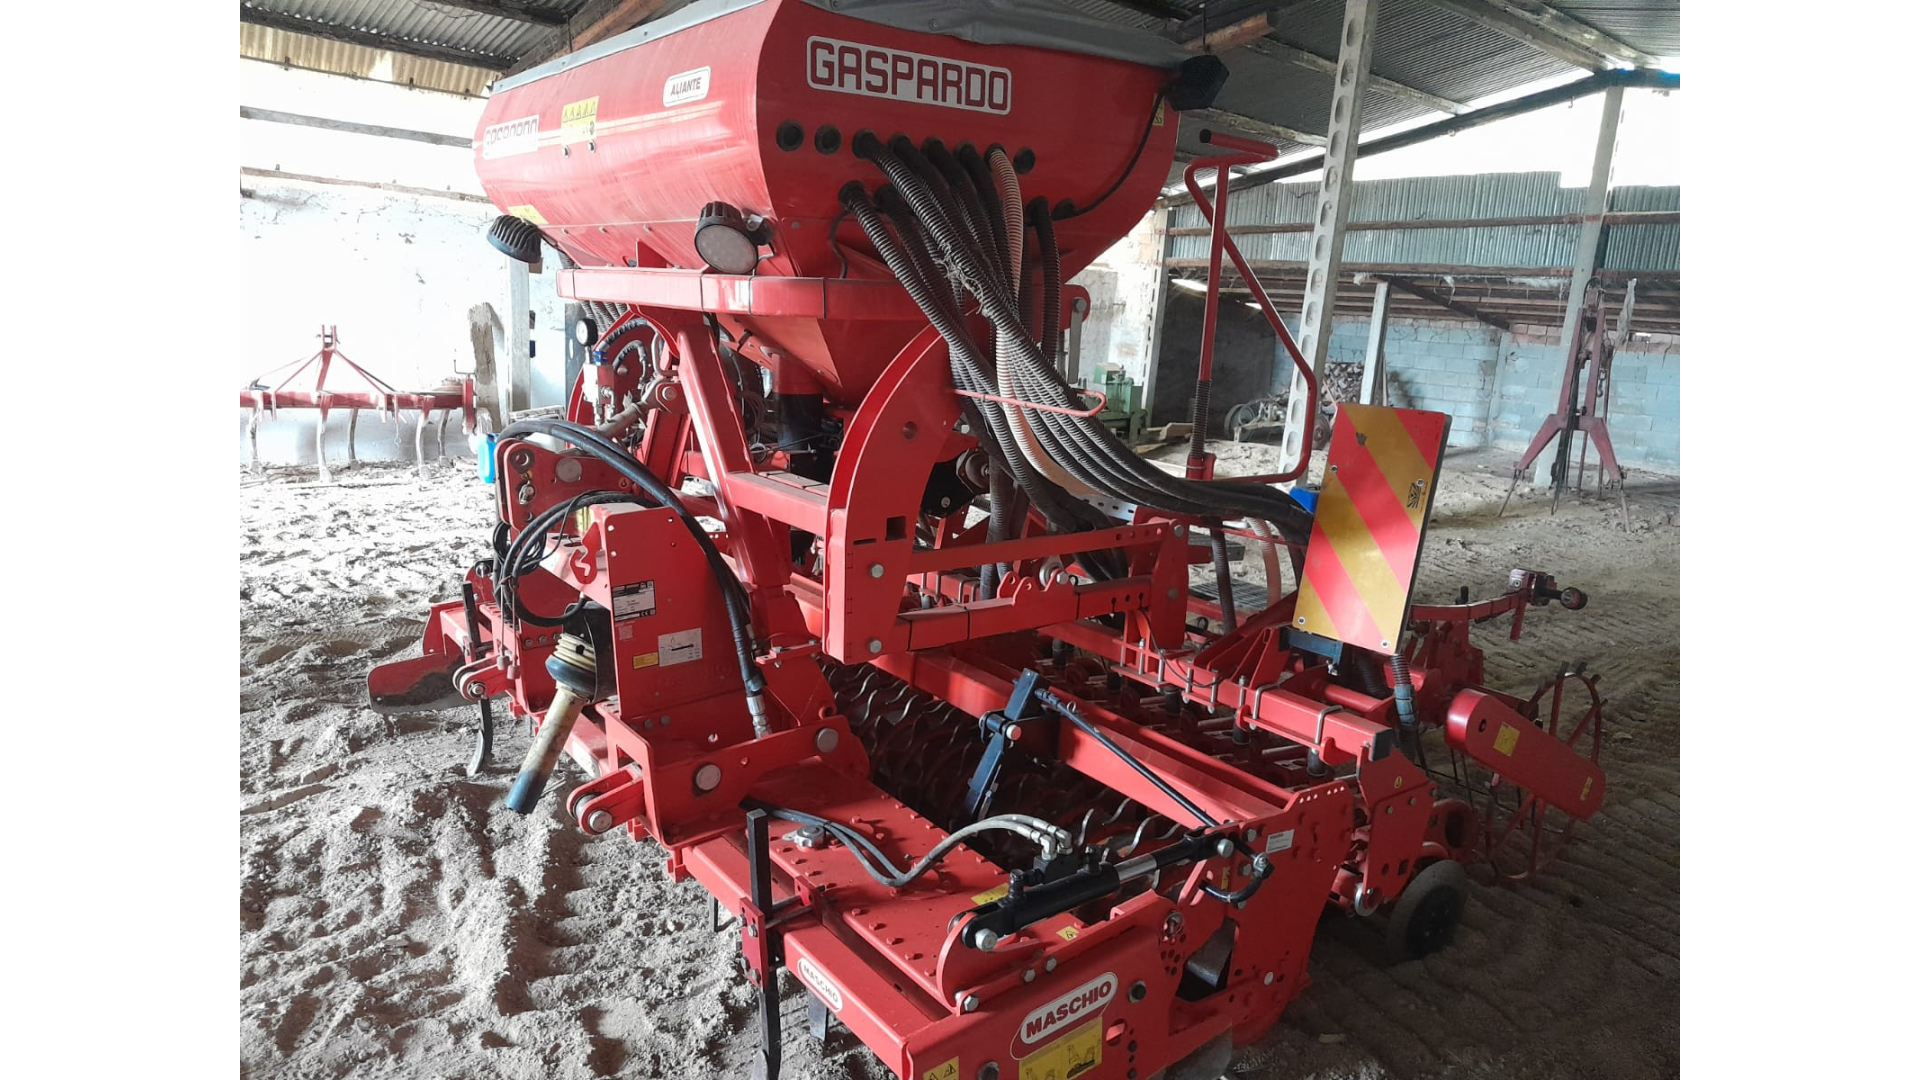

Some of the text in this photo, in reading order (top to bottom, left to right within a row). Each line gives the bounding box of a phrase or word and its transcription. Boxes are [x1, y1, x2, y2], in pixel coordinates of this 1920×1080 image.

[670, 77, 702, 96] ALIANTE
[810, 40, 1008, 111] GASPARDO
[803, 964, 838, 1003] MASCHIO
[1026, 980, 1112, 1039] MASCHIO
